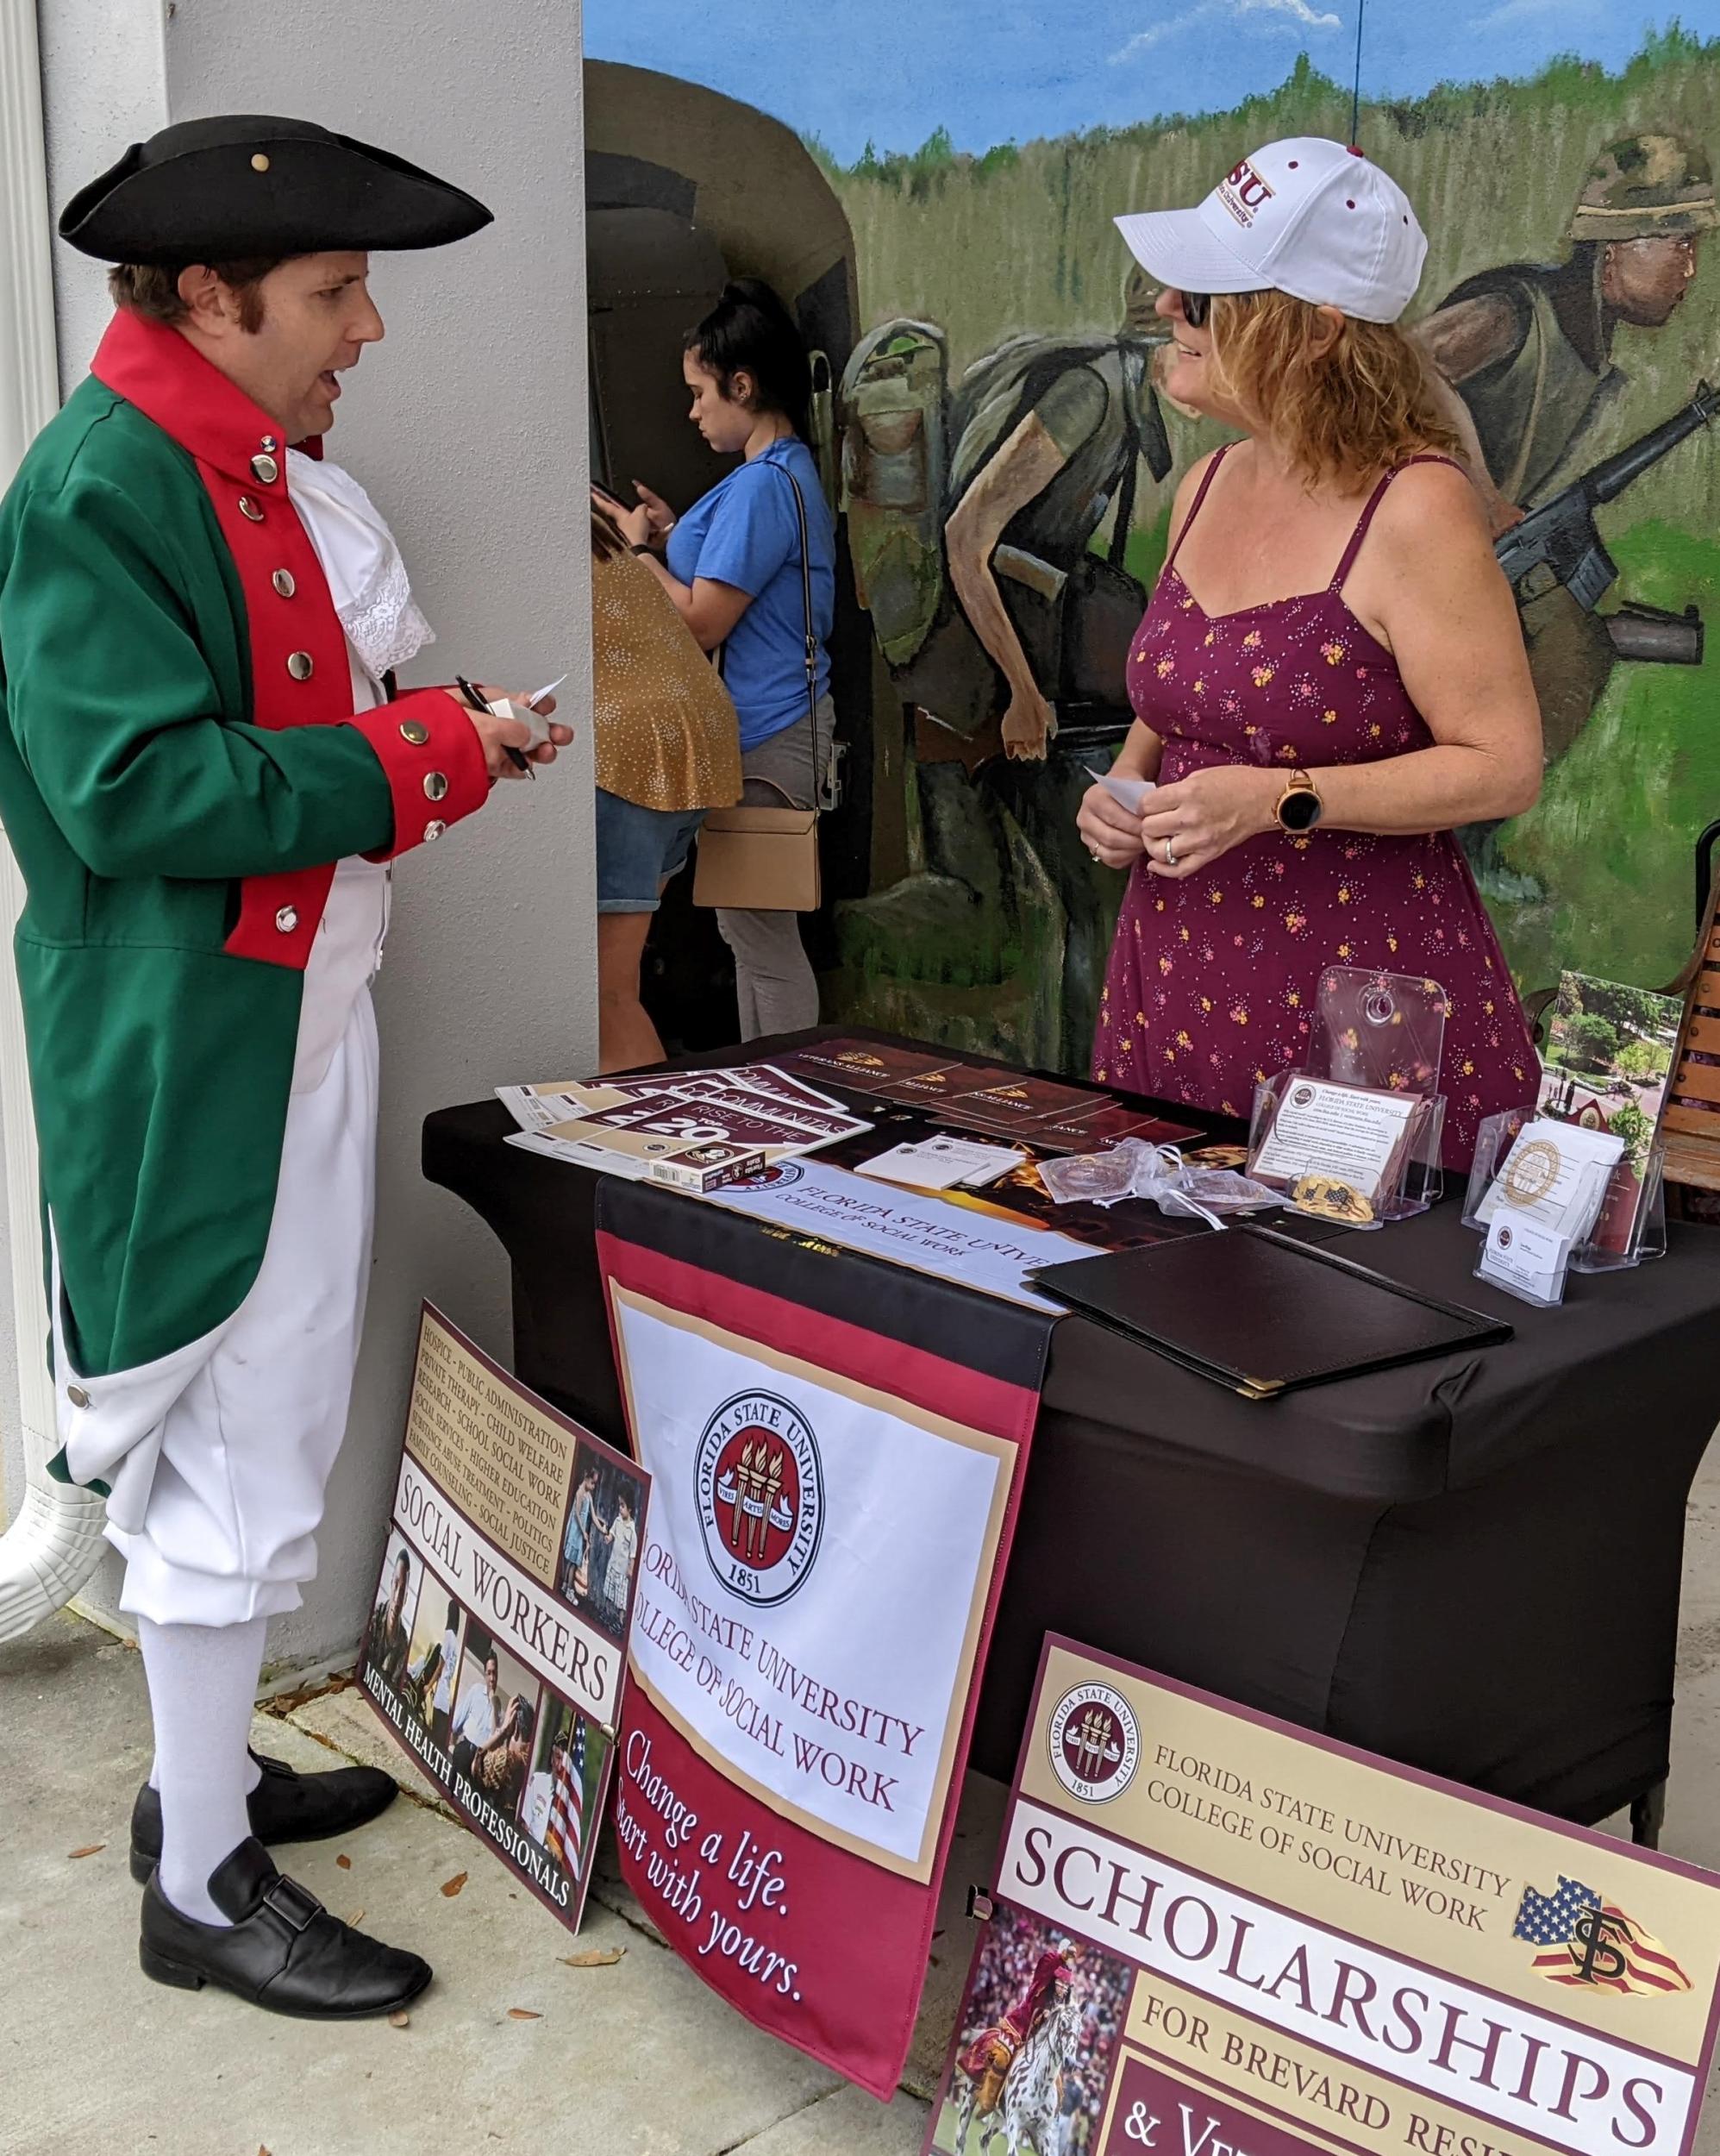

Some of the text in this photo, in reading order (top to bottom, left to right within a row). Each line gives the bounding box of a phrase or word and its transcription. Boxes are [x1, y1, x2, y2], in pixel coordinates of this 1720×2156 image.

[1228, 159, 1273, 207] SU
[643, 1117, 730, 1143] 20
[691, 1105, 805, 1141] RISE TO THE
[697, 1117, 722, 1127] TOP
[775, 1193, 844, 1218] COLLEGE
[861, 1221, 919, 1242] SOCIAL
[920, 1238, 966, 1257] WORK
[797, 1186, 1050, 1267] FLORIDA STATE UNIVE
[415, 1390, 435, 1418] SOCIAL
[436, 1410, 464, 1452] SERVICES
[469, 1447, 500, 1485] HIGHER
[502, 1474, 557, 1531] EDUCATION
[417, 1368, 451, 1412] RESEARCH
[457, 1408, 489, 1452] SCHOOL
[491, 1441, 524, 1481] SOCIAL
[528, 1470, 560, 1508] WORK
[421, 1348, 447, 1382] PRIVATE
[447, 1372, 479, 1415] THERAPY
[487, 1413, 515, 1447] CHILD
[518, 1438, 563, 1484] WELFARE
[424, 1325, 452, 1363] HOSPICE
[458, 1360, 485, 1395] PUBLIC
[486, 1388, 567, 1461] ADMINISTRATION
[409, 1427, 430, 1462] FAMILY
[430, 1452, 472, 1507] COUNSELING
[478, 1501, 509, 1540] SOCIAL
[510, 1532, 550, 1574] JUSTICE
[412, 1409, 442, 1452] SUBSTANCE
[442, 1445, 462, 1471] ABUSE
[462, 1463, 505, 1512] TREATMENT
[512, 1507, 553, 1552] POLITICS
[700, 1402, 816, 1576] FLORIDA STATE UNIVERSITY
[401, 1473, 607, 1702] SOCIAL WORKERS
[728, 1564, 761, 1594] 1851
[635, 1591, 899, 1812] OLLEGE OF SOCIAL WORK
[644, 1543, 925, 1757] ORIDA STATE UNIVERSITY
[363, 1662, 569, 1908] MENTAL HEALTH PROFESSIONALS
[1052, 1689, 1135, 1787] FLORIDA STATE UNIVERSITY
[1072, 1779, 1094, 1797] 1851
[616, 1776, 801, 2002] Start with yours.
[626, 1730, 787, 1915] Change a life.
[1148, 1779, 1489, 1934] COLLEGE OF SOCIAL WORK
[1153, 1744, 1512, 1899] FLORIDA STATE UNIVERSITY
[1015, 1827, 1664, 2149] SCHOLARSHIPS
[1124, 2101, 1161, 2147] &
[1142, 1994, 1210, 2053] FOR
[1221, 2030, 1392, 2131] BREVARD
[1403, 2113, 1513, 2156] RES
